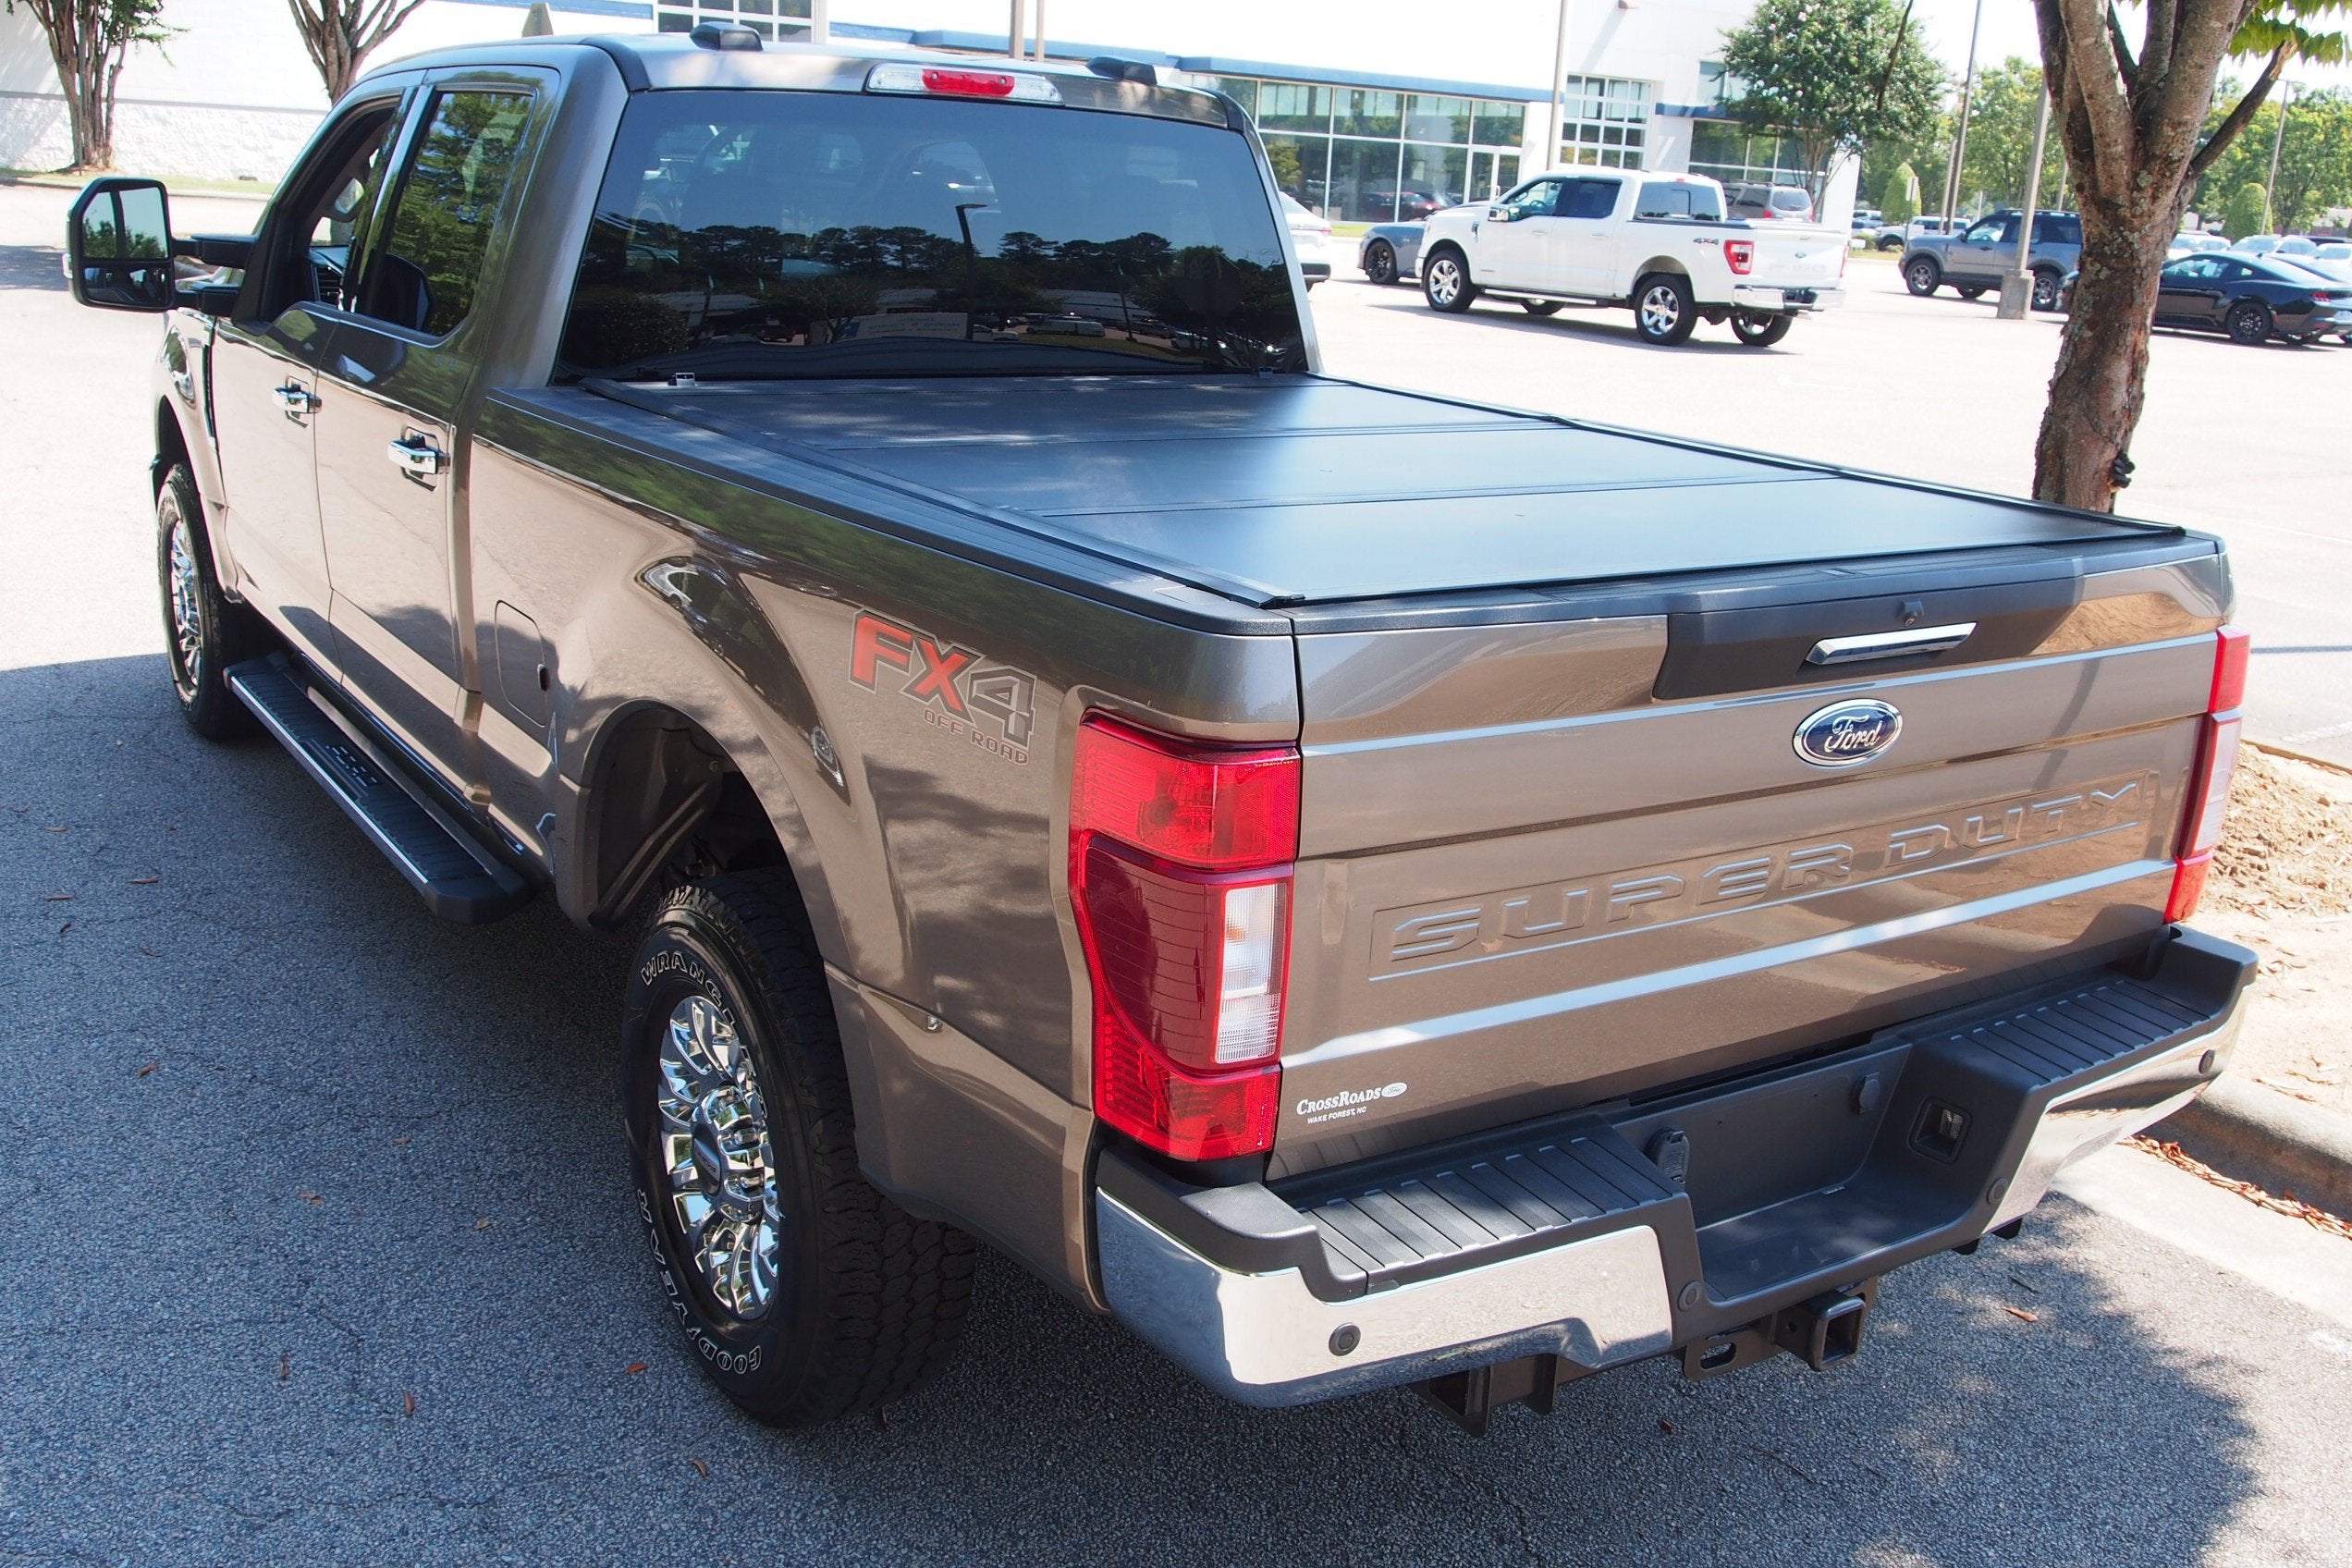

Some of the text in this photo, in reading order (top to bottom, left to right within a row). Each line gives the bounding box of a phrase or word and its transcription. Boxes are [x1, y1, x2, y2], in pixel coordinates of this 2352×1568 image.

[849, 606, 1037, 751] FX4
[925, 708, 1030, 766] OFF ROAD
[1824, 714, 1883, 753] Ford
[1390, 781, 2139, 962] SUPER DUTY
[1307, 1113, 1328, 1124] WAKE
[1356, 1106, 1367, 1115] NC
[637, 1188, 763, 1375] GOODYEAR
